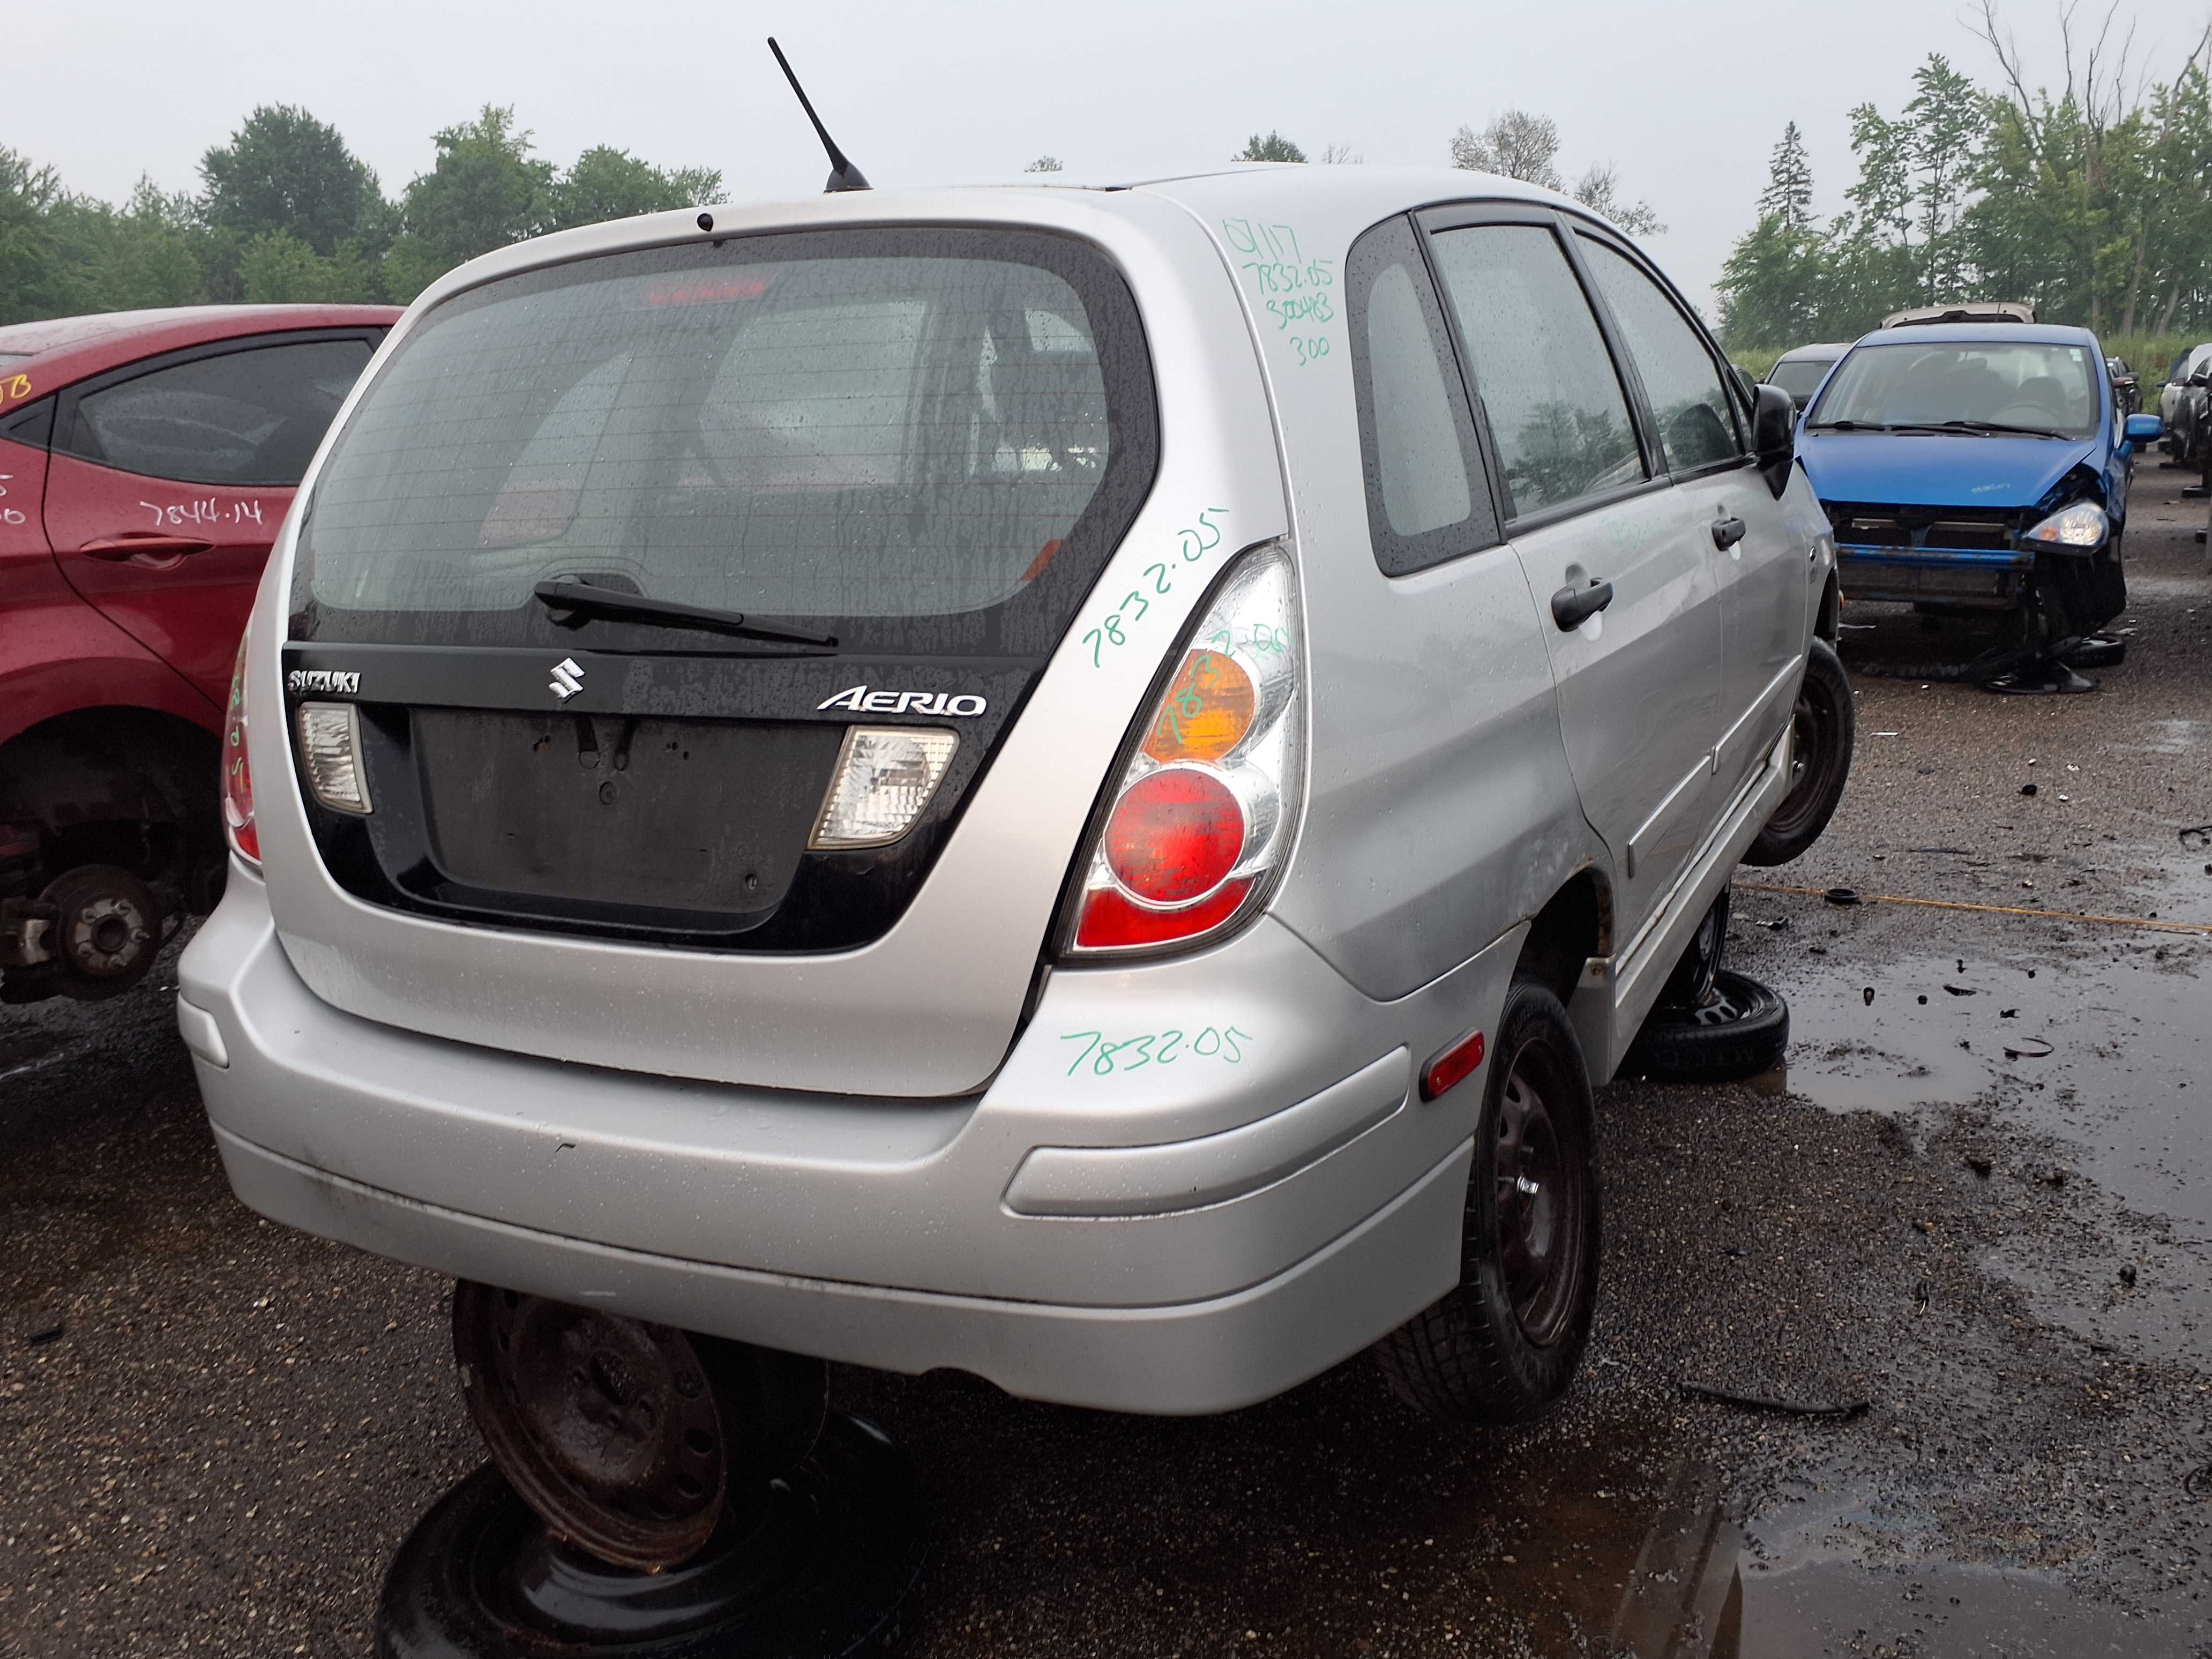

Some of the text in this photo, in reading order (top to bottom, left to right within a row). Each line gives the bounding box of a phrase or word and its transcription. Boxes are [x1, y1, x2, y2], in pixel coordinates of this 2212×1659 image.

[1242, 258, 1333, 295] 7832.05
[1290, 336, 1331, 367] 300
[139, 497, 263, 526] 7844.14
[1082, 507, 1230, 668] 7832.05
[287, 670, 361, 693] SUZUKI
[817, 685, 987, 717] AERIO
[1059, 1026, 1253, 1076] 7832.05
